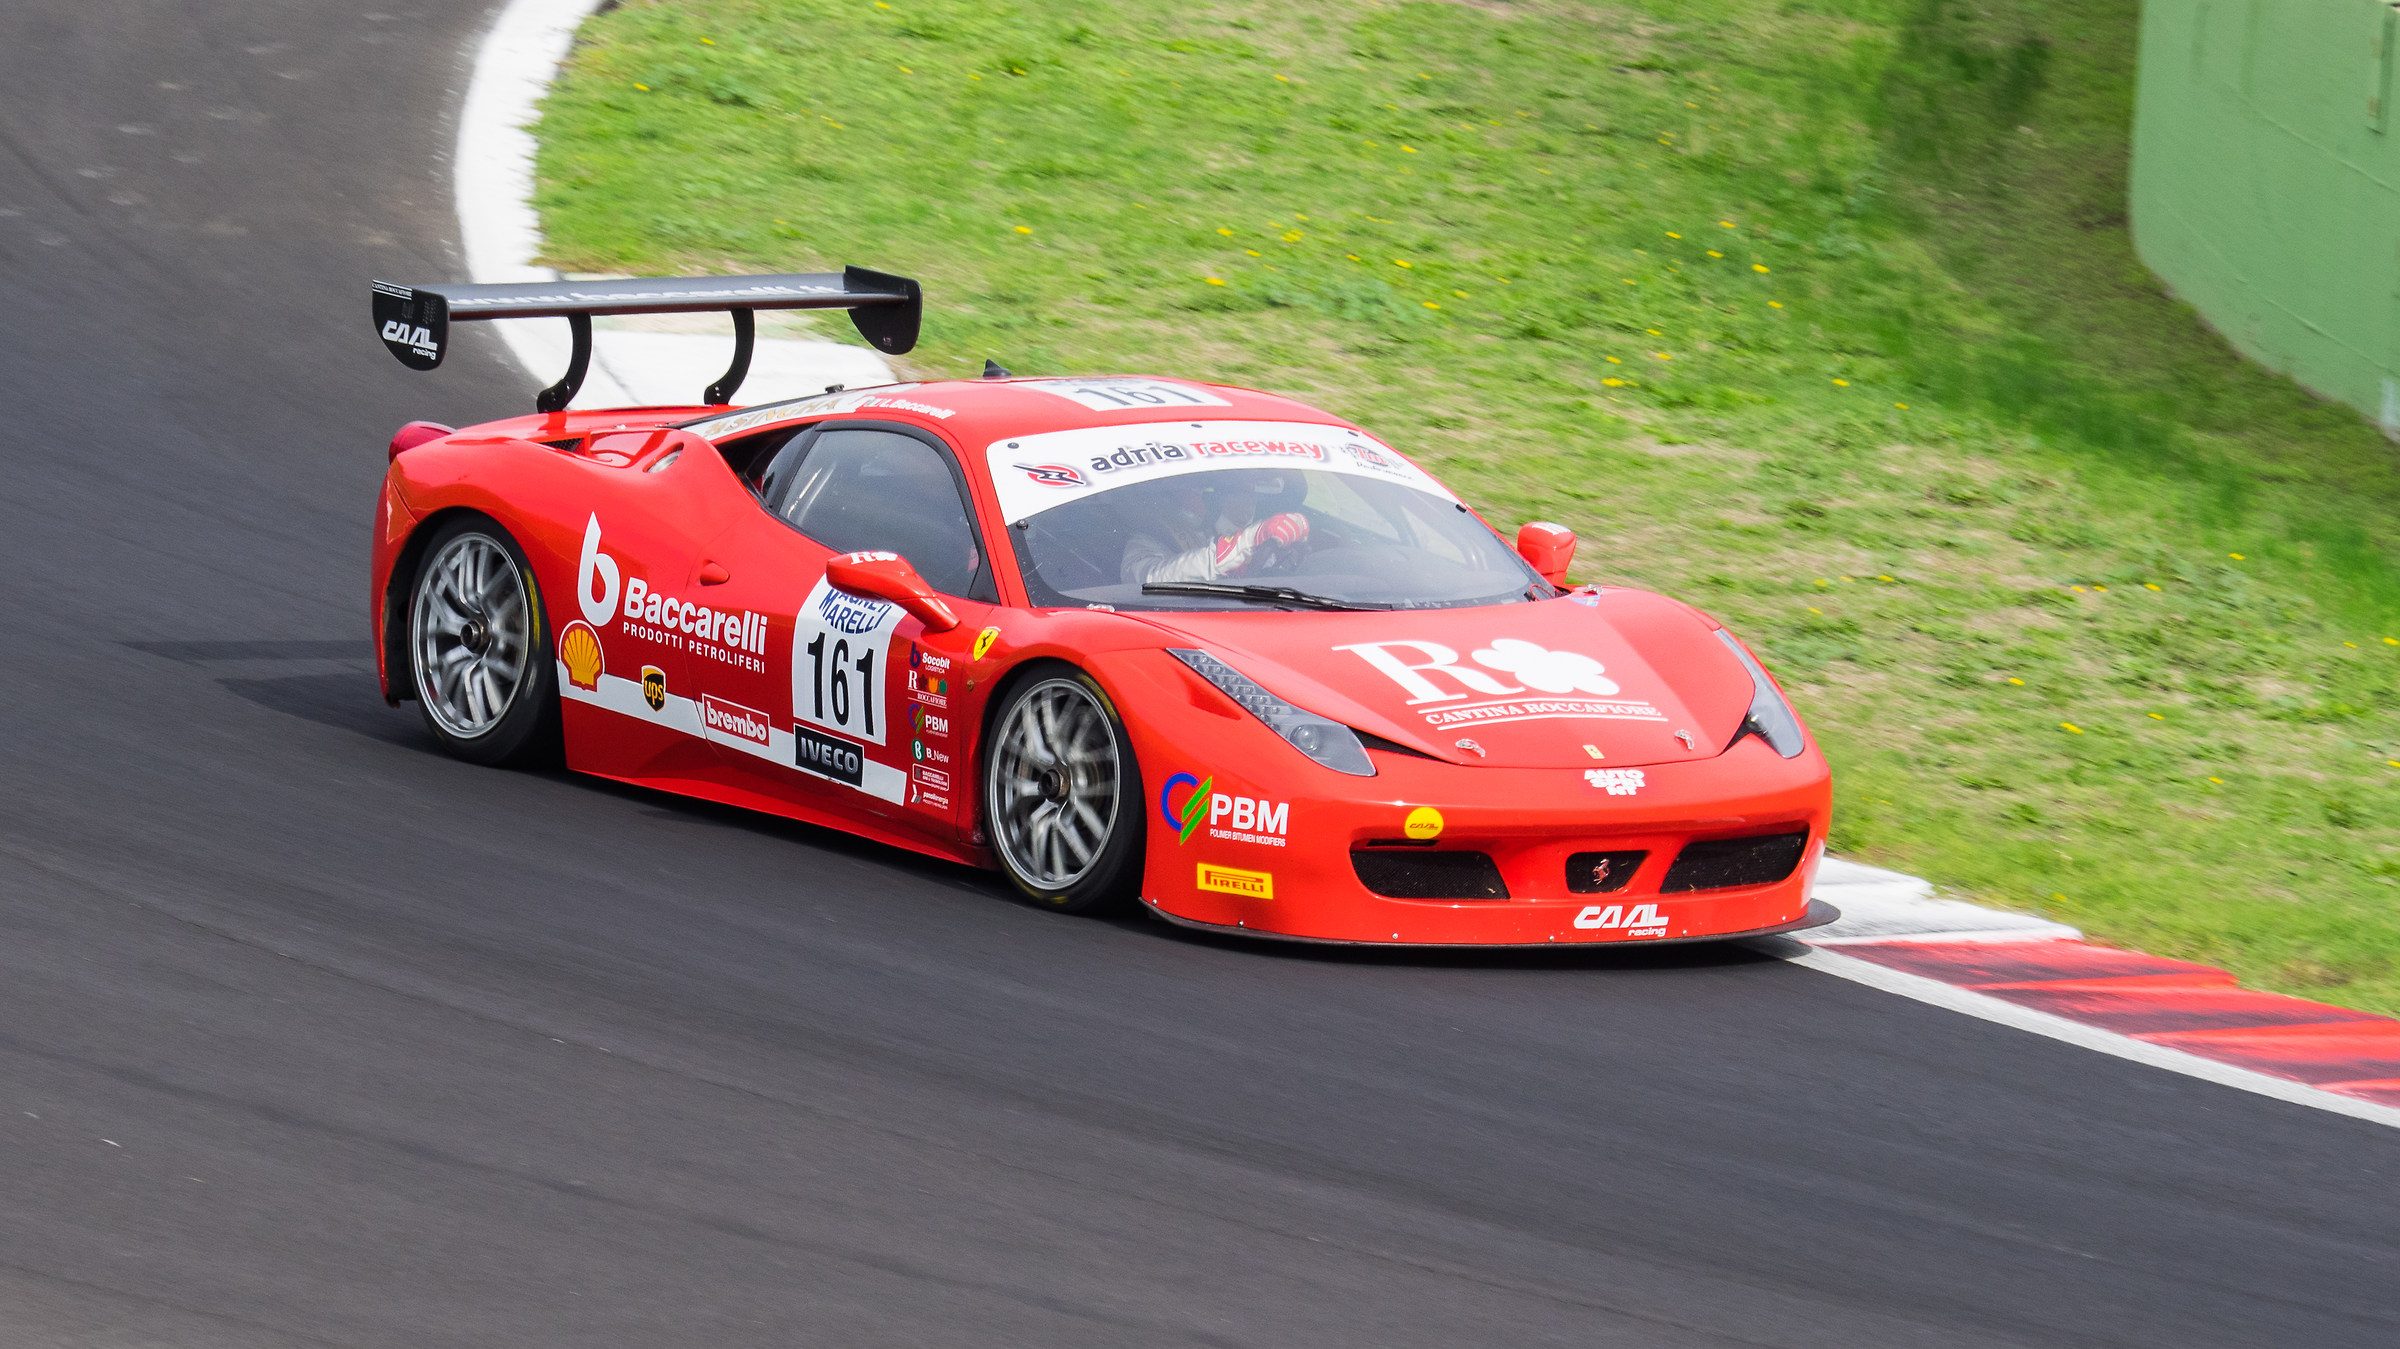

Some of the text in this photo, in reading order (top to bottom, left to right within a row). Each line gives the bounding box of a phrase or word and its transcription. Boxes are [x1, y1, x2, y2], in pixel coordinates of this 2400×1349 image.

[382, 320, 438, 351] CAAL
[412, 347, 437, 360] racing
[1073, 385, 1206, 407] 161
[1090, 440, 1323, 471] adria raceway
[623, 576, 768, 655] Baccarelli
[818, 592, 893, 634] MARELLI
[623, 621, 766, 675] PRODOTTI PETROLIFERI
[922, 652, 950, 670] Socobit
[644, 680, 664, 706] ups
[807, 631, 875, 738] 161
[706, 700, 767, 742] brembo
[925, 714, 949, 733] PBM
[1426, 705, 1522, 726] CANTINA
[801, 736, 859, 775] IVECO
[1584, 769, 1645, 780] AUTO
[1210, 793, 1289, 835] PBM
[1204, 870, 1264, 893] PIRELLI
[1573, 904, 1669, 929] CAAL
[1628, 926, 1666, 937] racing
